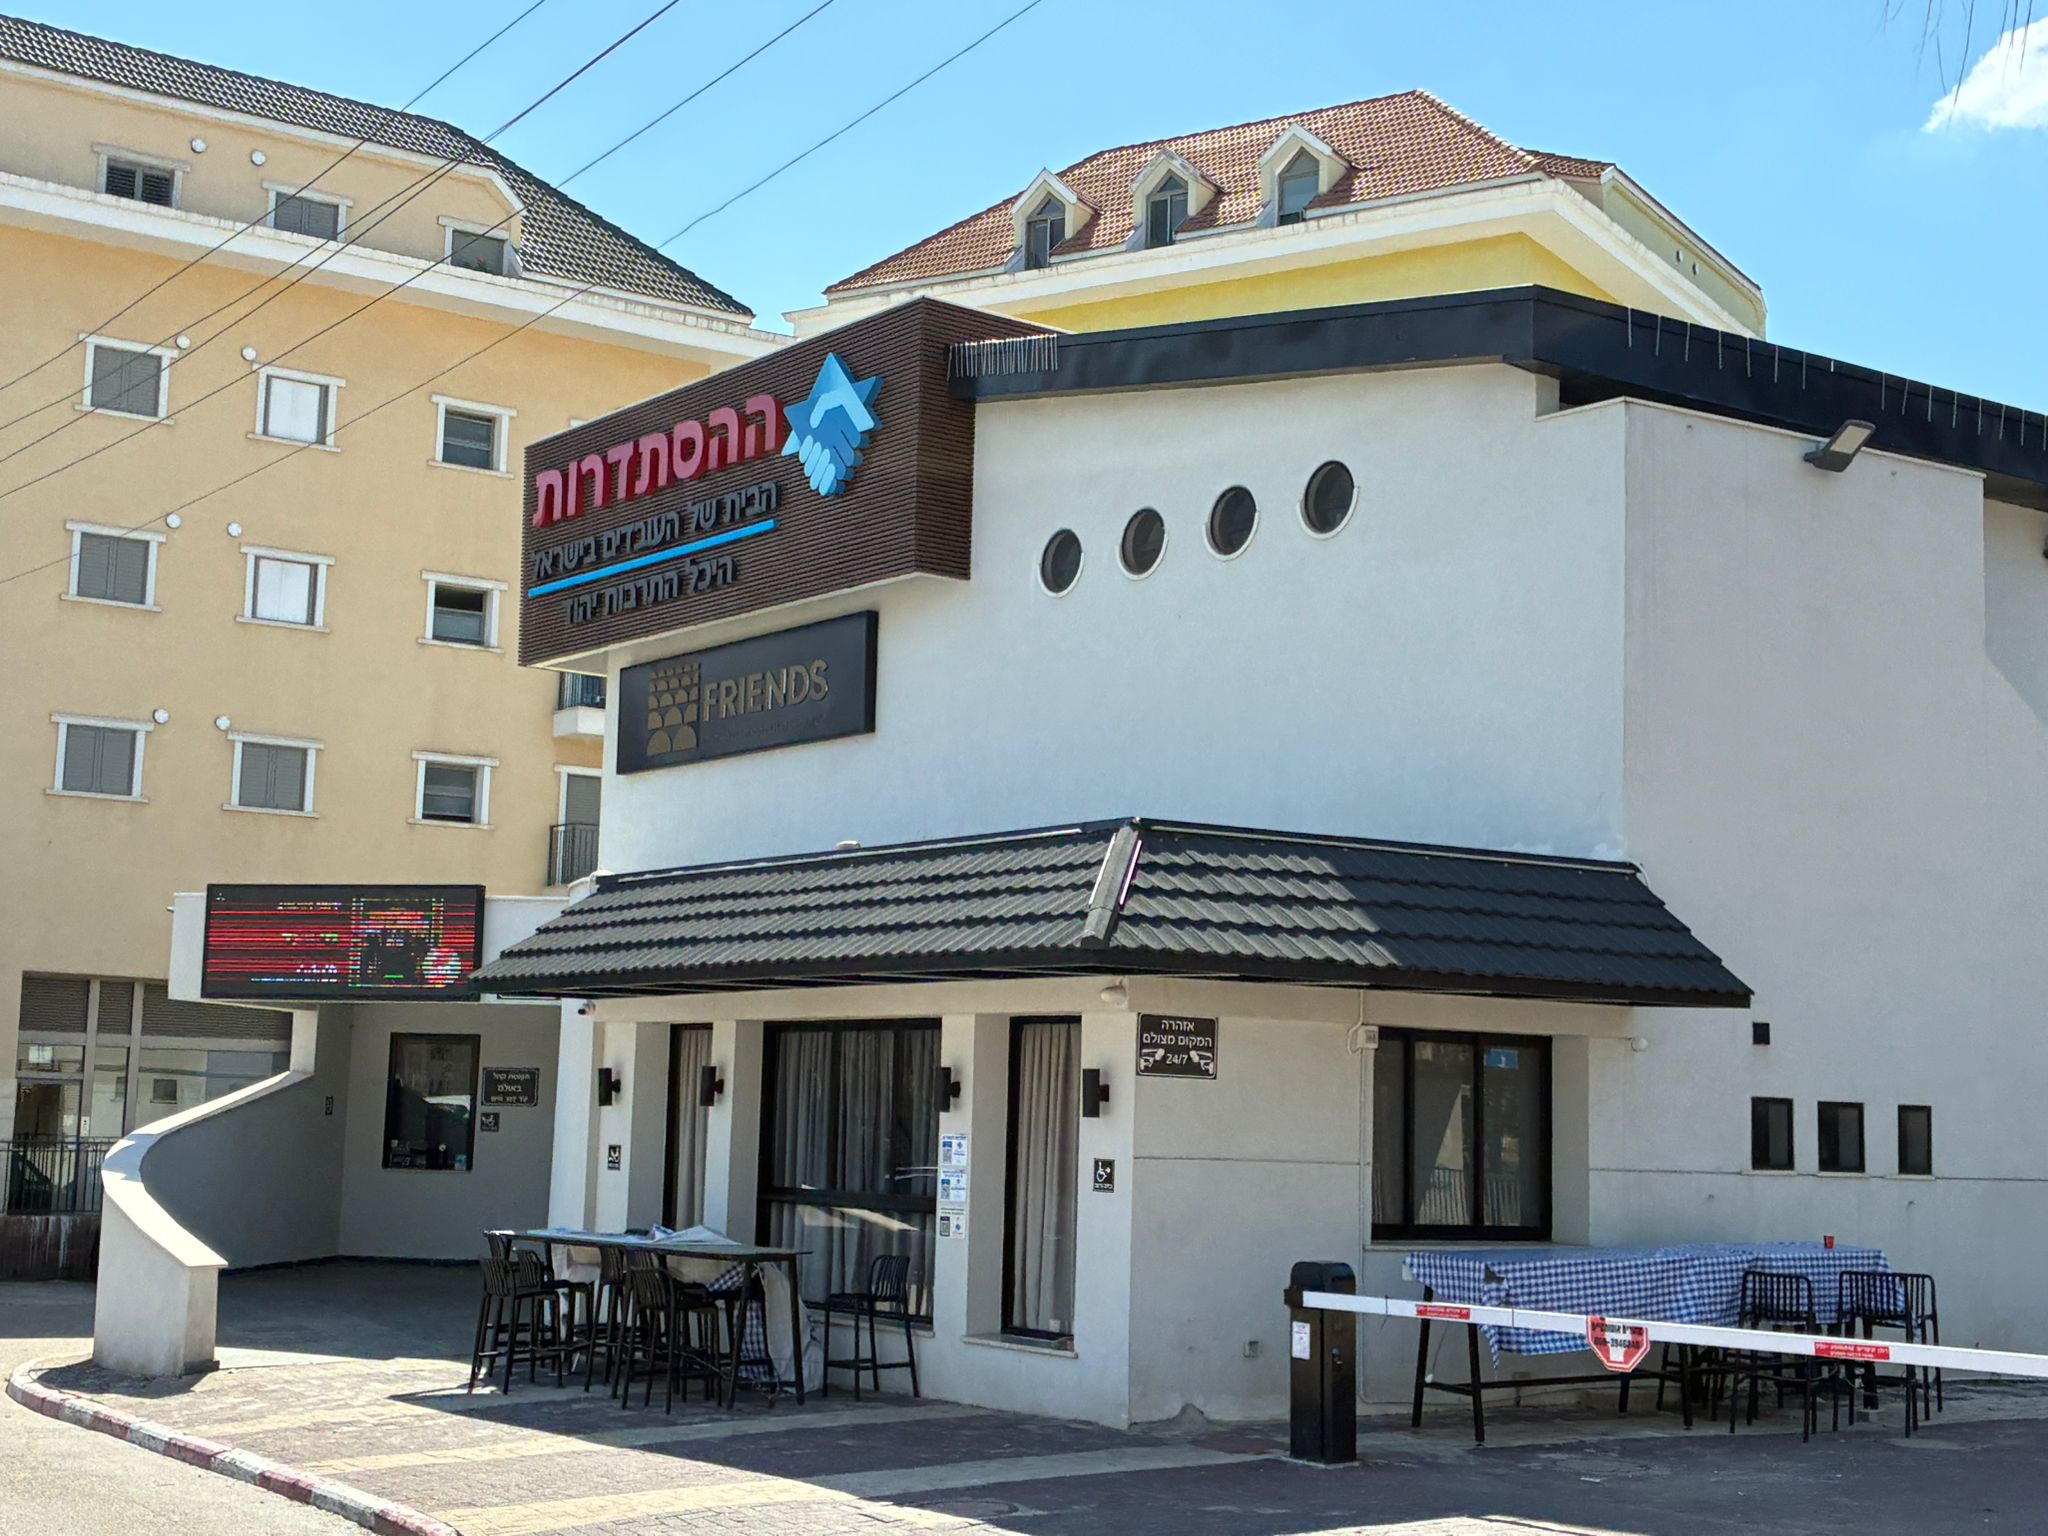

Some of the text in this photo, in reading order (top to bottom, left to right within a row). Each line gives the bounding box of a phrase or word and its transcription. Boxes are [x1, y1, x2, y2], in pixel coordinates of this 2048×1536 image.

[532, 394, 781, 527] ההסתדרות
[686, 499, 719, 531] של
[723, 481, 780, 524] הבית
[603, 511, 681, 559] העובדים
[604, 571, 681, 616] התרבות
[683, 555, 737, 593] היכל
[702, 658, 830, 723] FRIENDS
[1142, 1032, 1212, 1048] המקום מצולם
[1161, 1020, 1195, 1032] אזהרה
[1166, 1053, 1188, 1065] 24/7
